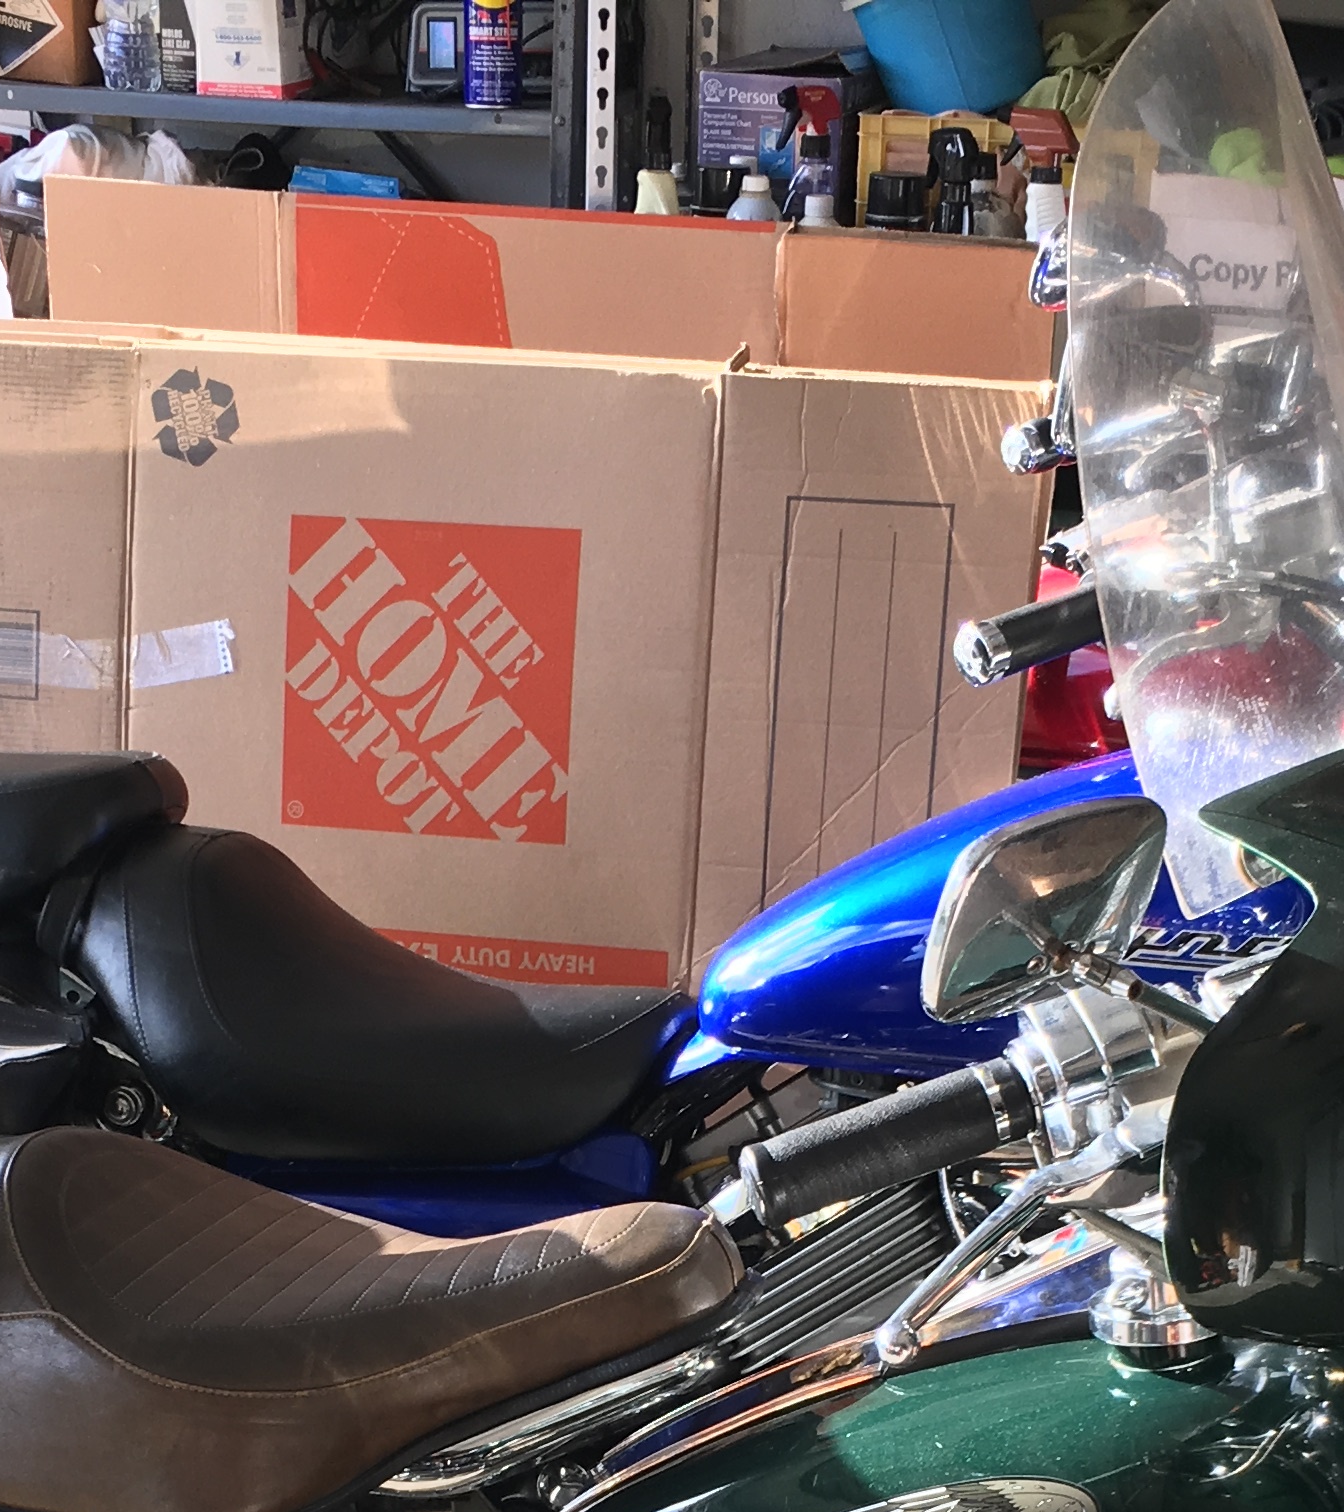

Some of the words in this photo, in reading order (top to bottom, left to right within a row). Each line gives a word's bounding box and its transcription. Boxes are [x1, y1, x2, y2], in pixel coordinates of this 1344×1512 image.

[728, 87, 778, 105] Person
[1189, 253, 1268, 291] Copy
[167, 389, 190, 452] RECYCLED
[181, 389, 207, 447] 100%
[432, 552, 544, 689] THE
[288, 516, 569, 842] HOME
[286, 638, 460, 834] DEPOT
[452, 946, 511, 969] DUTY
[519, 950, 595, 976] HEAVY
